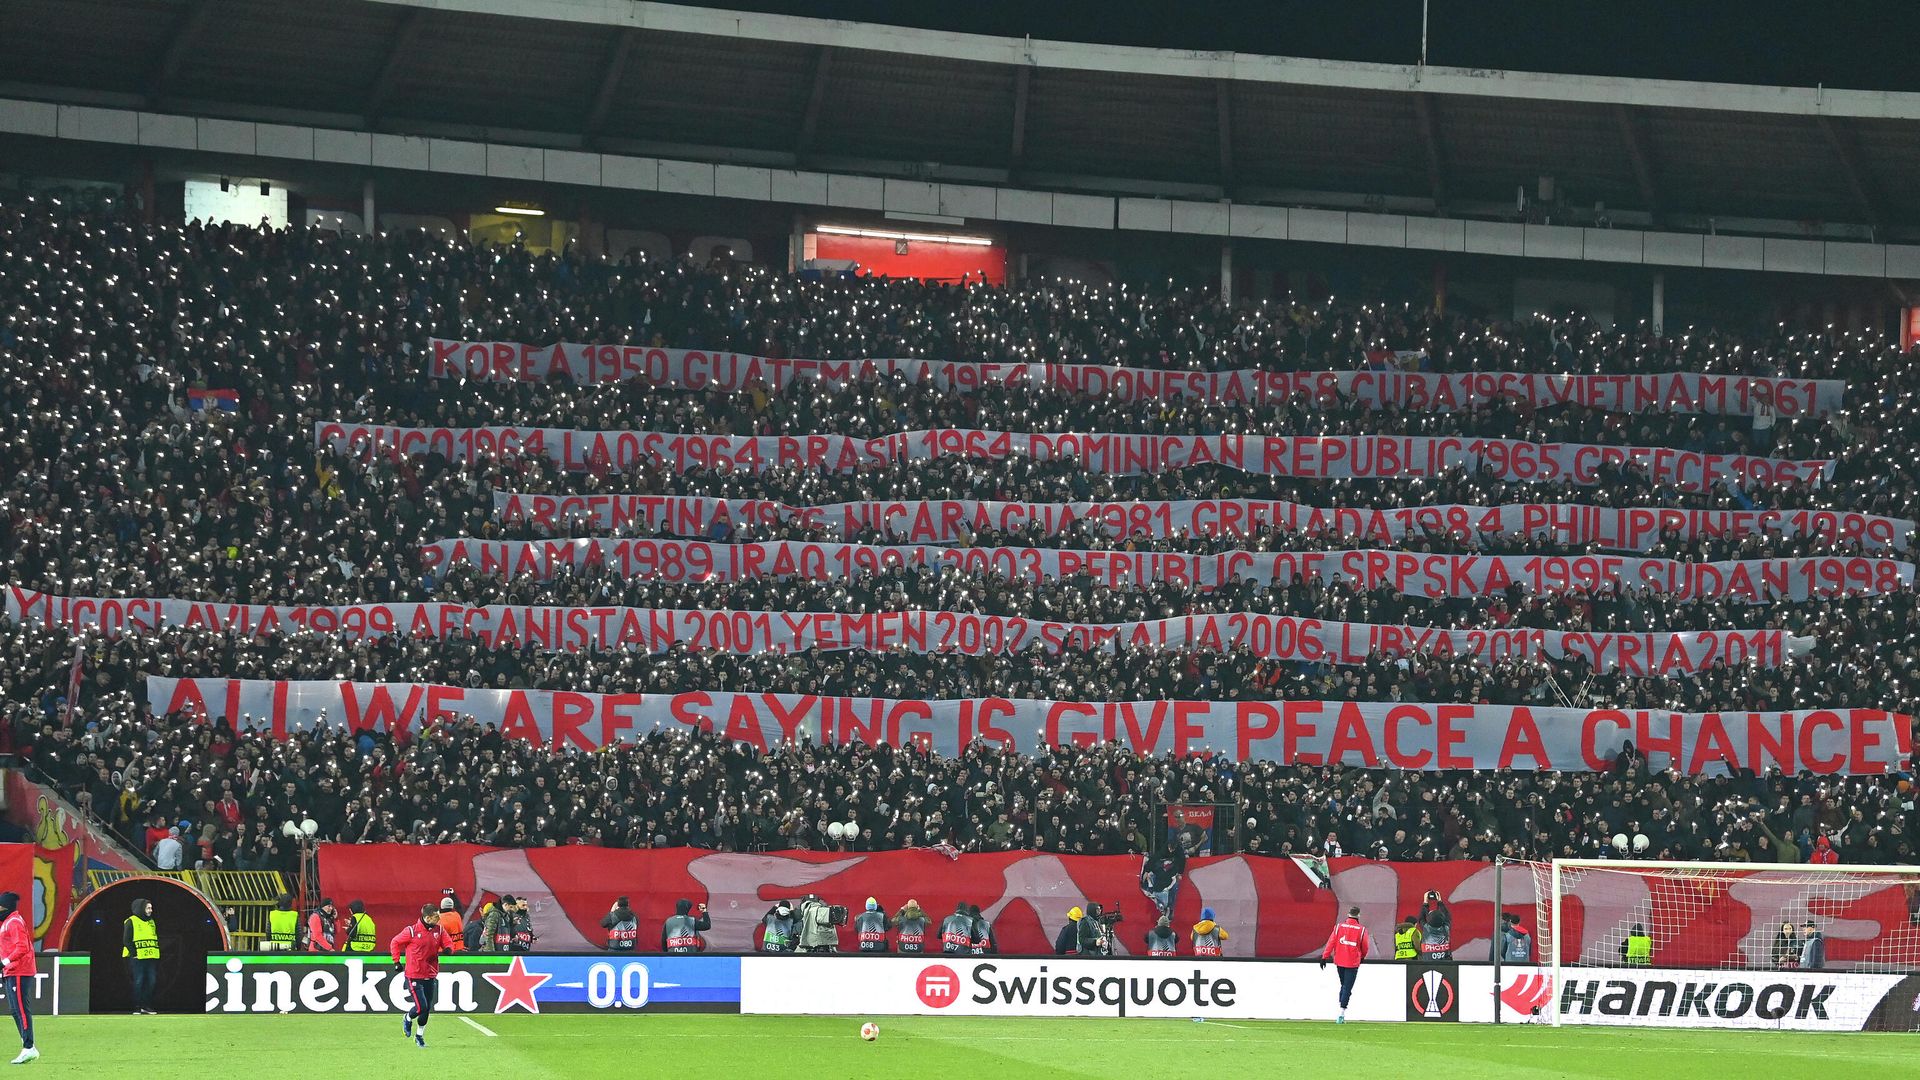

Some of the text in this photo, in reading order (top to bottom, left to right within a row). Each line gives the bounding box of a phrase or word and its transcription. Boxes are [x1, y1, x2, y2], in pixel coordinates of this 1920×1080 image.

[433, 340, 573, 387] KOREA
[1045, 362, 1246, 407] INDONESIA
[1351, 371, 1457, 412] CUBA
[1545, 372, 1727, 415] VIETNAM
[564, 431, 664, 472] LAOS
[1030, 433, 1244, 474] DOMINICAN
[1263, 436, 1462, 478] REPUBLIC
[845, 500, 1080, 542] NICARAGUA
[1192, 500, 1393, 545] GRENADA
[1395, 507, 1504, 546] 1984
[1523, 504, 1782, 550] PHILIPPINES
[421, 540, 604, 582] PANAMA
[729, 542, 829, 583] IRAQ
[1058, 551, 1254, 593] REPUBLIC
[1272, 553, 1325, 588] OF
[1341, 551, 1513, 598] SRPSKA
[1525, 556, 1625, 597] 1995
[1639, 561, 1788, 603] SUDAN
[1800, 558, 1899, 598] 1998
[410, 602, 676, 653] AFGANISTAN
[780, 612, 927, 652] YEMEN
[1342, 623, 1455, 664] LIBYA
[1561, 632, 1694, 677] SYRIA
[1696, 629, 1783, 669] 2011
[502, 690, 643, 752] ARE
[670, 690, 933, 757] SAYING
[958, 696, 1017, 757] IS
[1045, 700, 1213, 760] GIVE
[1236, 700, 1475, 768] PEACE
[1497, 706, 1552, 770] A
[1580, 709, 1912, 776] CHANCE!
[669, 938, 694, 947] PHOTO
[586, 961, 650, 1009] 0.0
[971, 962, 1237, 1018] Swissquote
